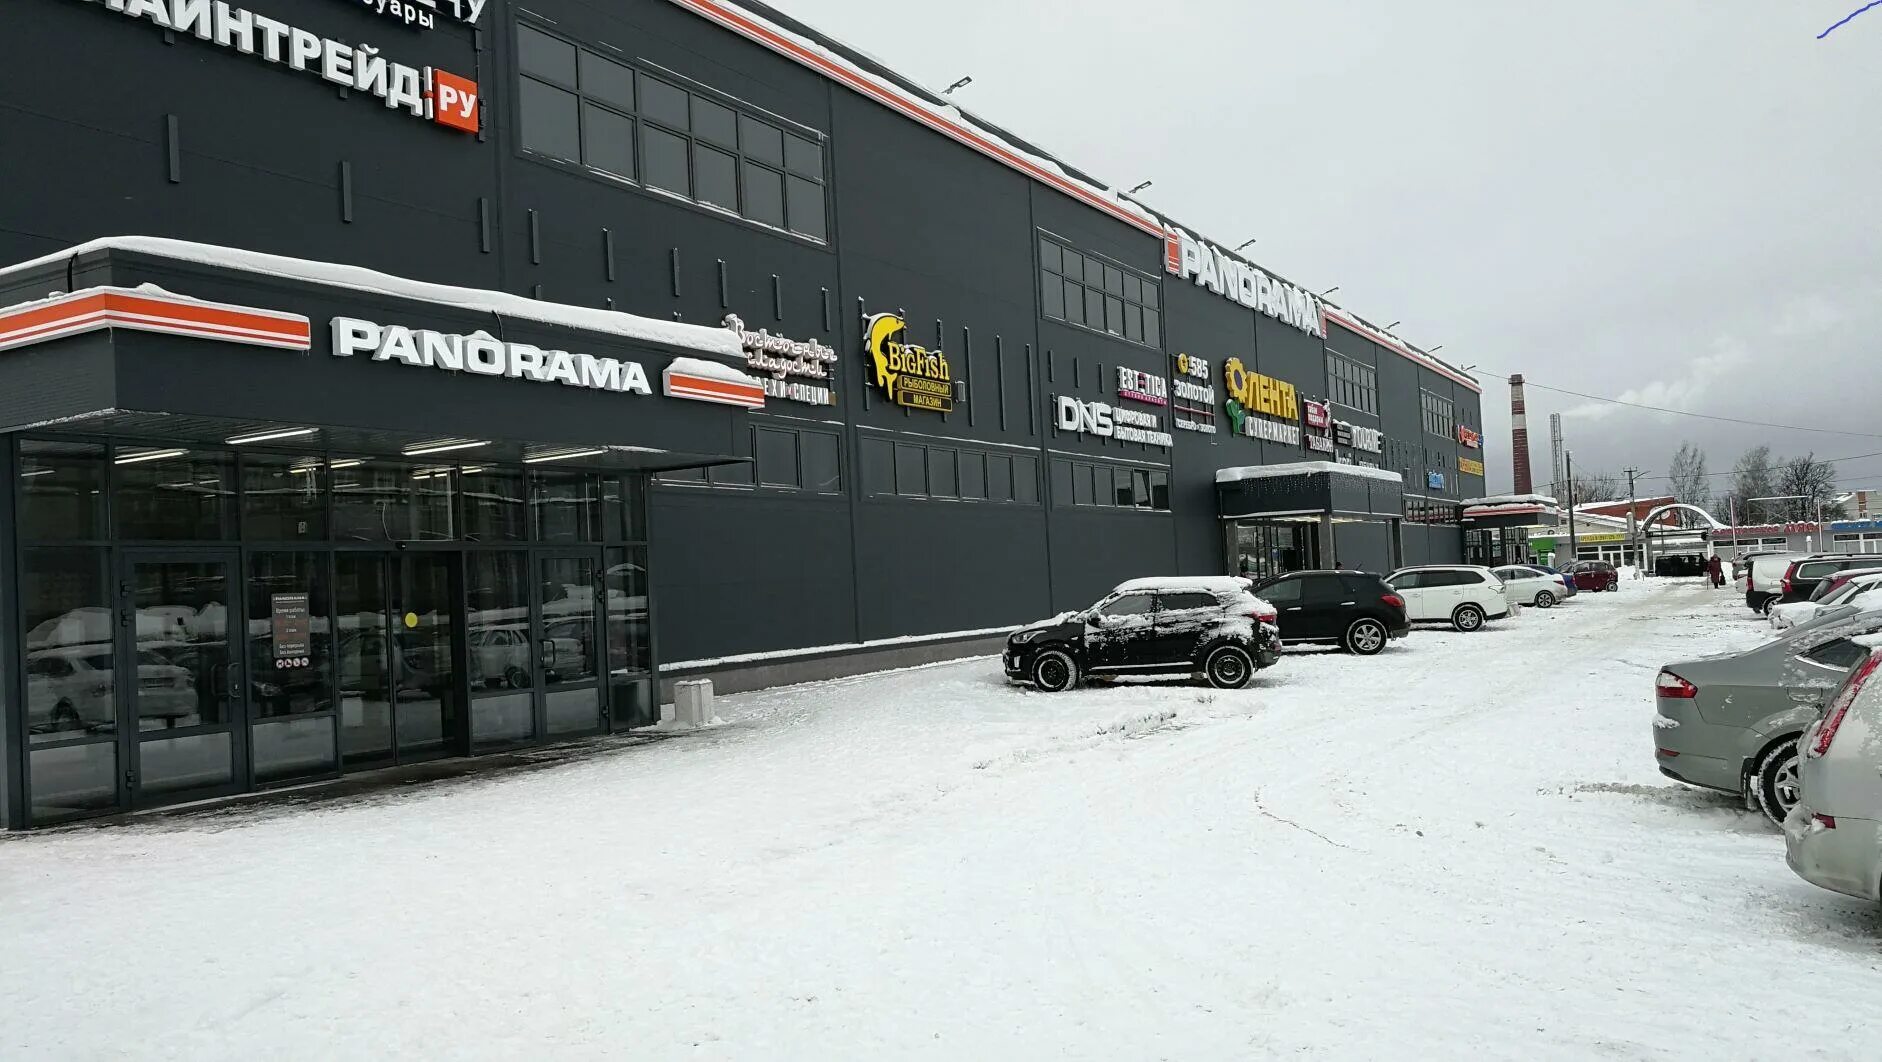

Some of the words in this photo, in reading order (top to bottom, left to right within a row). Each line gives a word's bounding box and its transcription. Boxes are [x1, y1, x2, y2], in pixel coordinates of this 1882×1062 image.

[1178, 228, 1321, 337] PANORAMA
[329, 316, 653, 396] PANORAMA
[1187, 355, 1209, 380] 585
[793, 382, 830, 406] СПЕЦИИ
[903, 375, 950, 395] РЫБОЛОВНЫЙ
[1174, 379, 1215, 406] ЗОЛОТОЙ
[1245, 371, 1300, 421] ЛЕНТА
[913, 393, 942, 408] МАГАЗИН
[1058, 395, 1114, 437] DNS
[1113, 407, 1151, 428] ЦИФРОВАЯ
[1114, 425, 1147, 443] БЫТОВАЯ
[1245, 416, 1300, 446] СУПЕРМАРКЕТ
